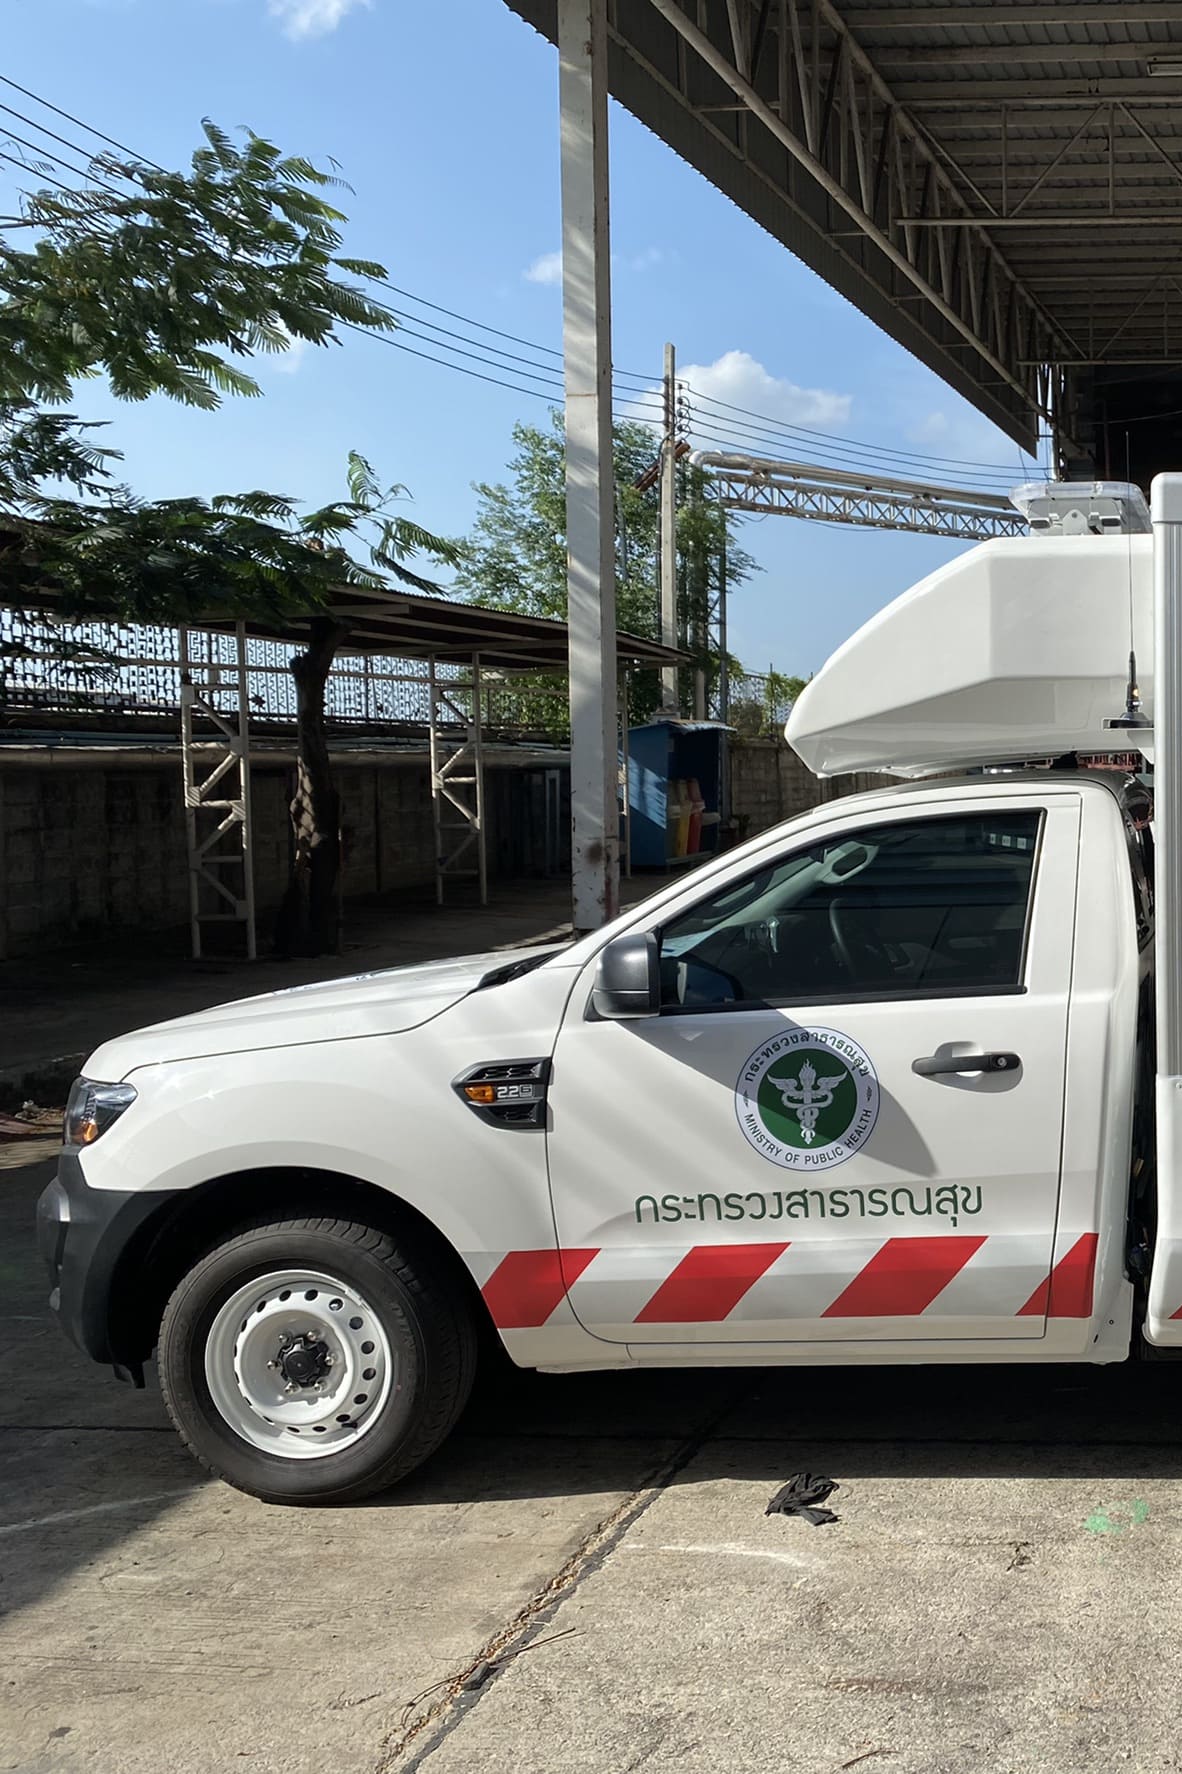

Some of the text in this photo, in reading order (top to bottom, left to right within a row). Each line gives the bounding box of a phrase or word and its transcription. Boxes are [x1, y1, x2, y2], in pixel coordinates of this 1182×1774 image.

[744, 1030, 871, 1082] กระทรวงสาธารณสุข
[744, 1108, 873, 1165] MINISTRY OF PUBLIC HEALTH
[634, 1183, 983, 1227] กระทรวงสาธารณสุข
